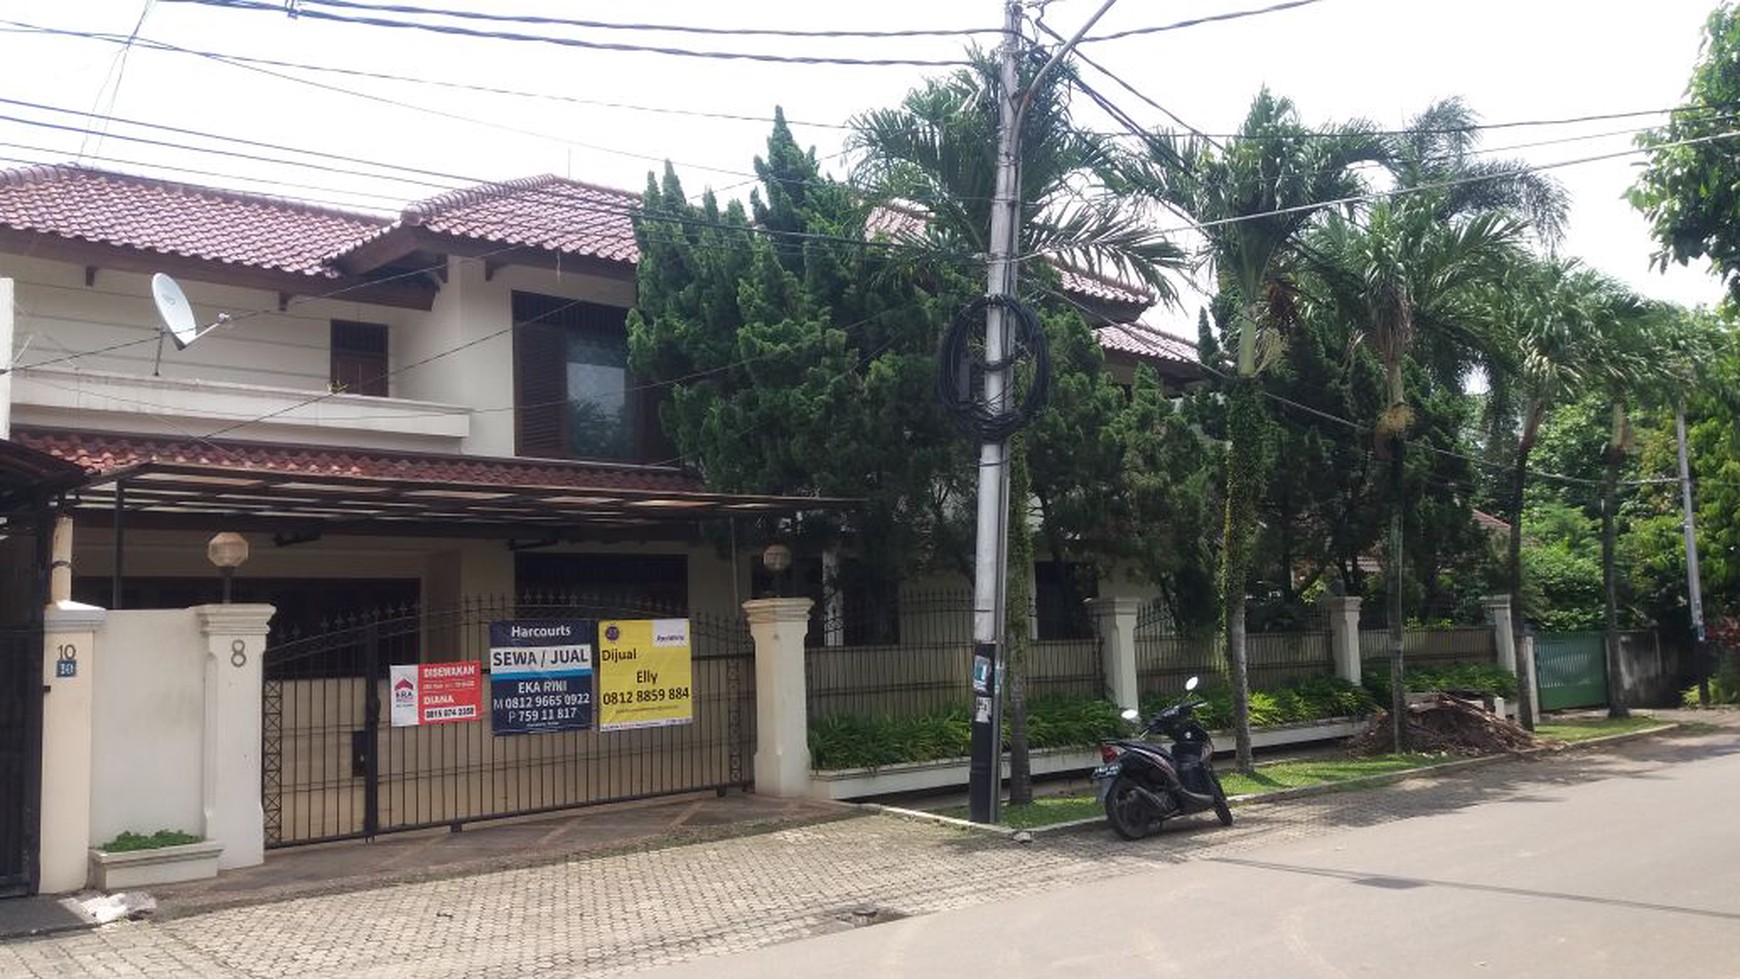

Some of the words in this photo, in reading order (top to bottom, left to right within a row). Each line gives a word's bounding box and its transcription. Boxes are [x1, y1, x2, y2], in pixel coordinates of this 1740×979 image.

[511, 625, 571, 638] Harcourts
[57, 644, 76, 660] 10
[230, 639, 247, 668] 8
[493, 651, 537, 666] SEWA
[540, 650, 546, 668] /
[550, 648, 589, 664] JUAL
[602, 648, 637, 663] Dijual
[424, 665, 475, 678] DISEWAKAN
[636, 670, 659, 684] Elly
[518, 682, 541, 693] EKA
[543, 681, 568, 692] RINI
[423, 694, 455, 705] DIANA
[505, 697, 533, 709] 0812
[535, 695, 562, 707] 9665
[564, 693, 590, 705] 0922
[603, 692, 634, 705] 0812
[636, 689, 666, 703] 8859
[668, 687, 690, 701] 884
[519, 710, 539, 722] 759
[557, 708, 578, 719] 817
